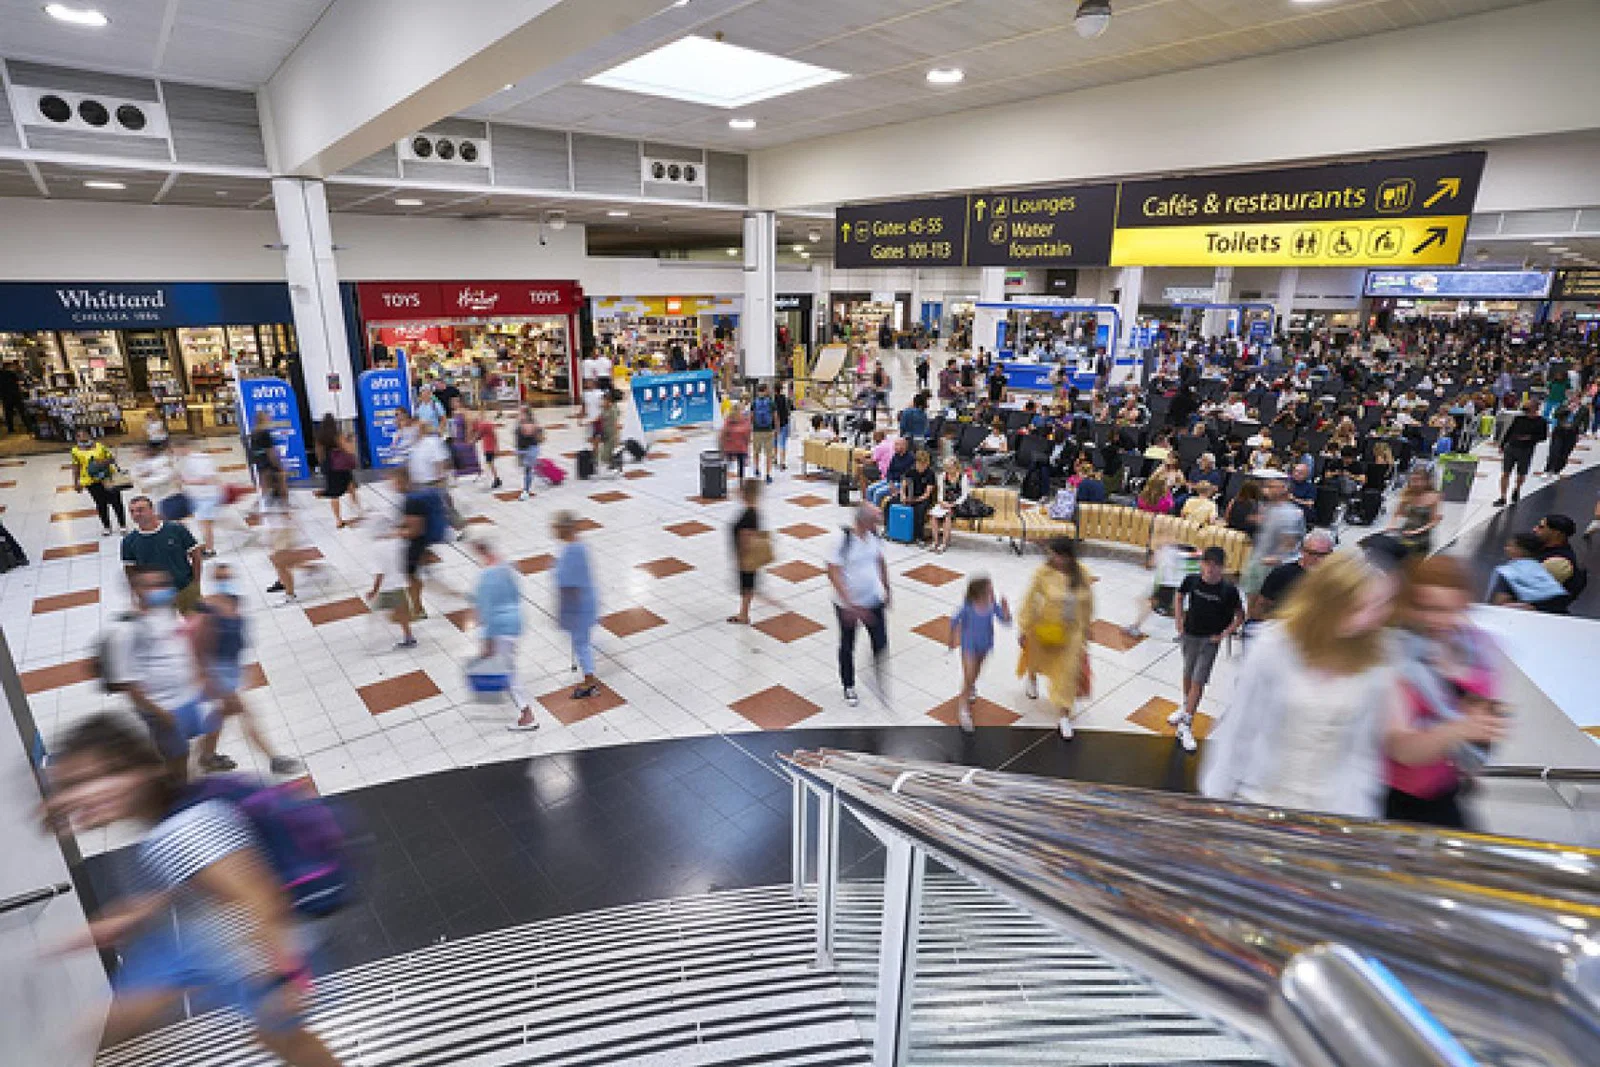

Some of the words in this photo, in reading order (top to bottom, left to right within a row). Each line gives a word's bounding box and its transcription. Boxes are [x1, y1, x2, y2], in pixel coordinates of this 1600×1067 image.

[1012, 196, 1077, 215] Lounges
[1143, 193, 1198, 217] Cafés
[1203, 191, 1220, 214] &
[1225, 186, 1366, 213] restaurants
[872, 220, 907, 236] Gates
[908, 217, 944, 235] 45-55
[1012, 222, 1056, 238] Water
[870, 242, 907, 259] Gates
[1009, 240, 1073, 257] fountain
[1205, 231, 1282, 253] Toilets
[56, 289, 166, 310] Whittard
[382, 292, 421, 308] TOYS
[528, 289, 562, 305] TOYS
[252, 384, 287, 399] atm
[370, 376, 400, 390] atm
